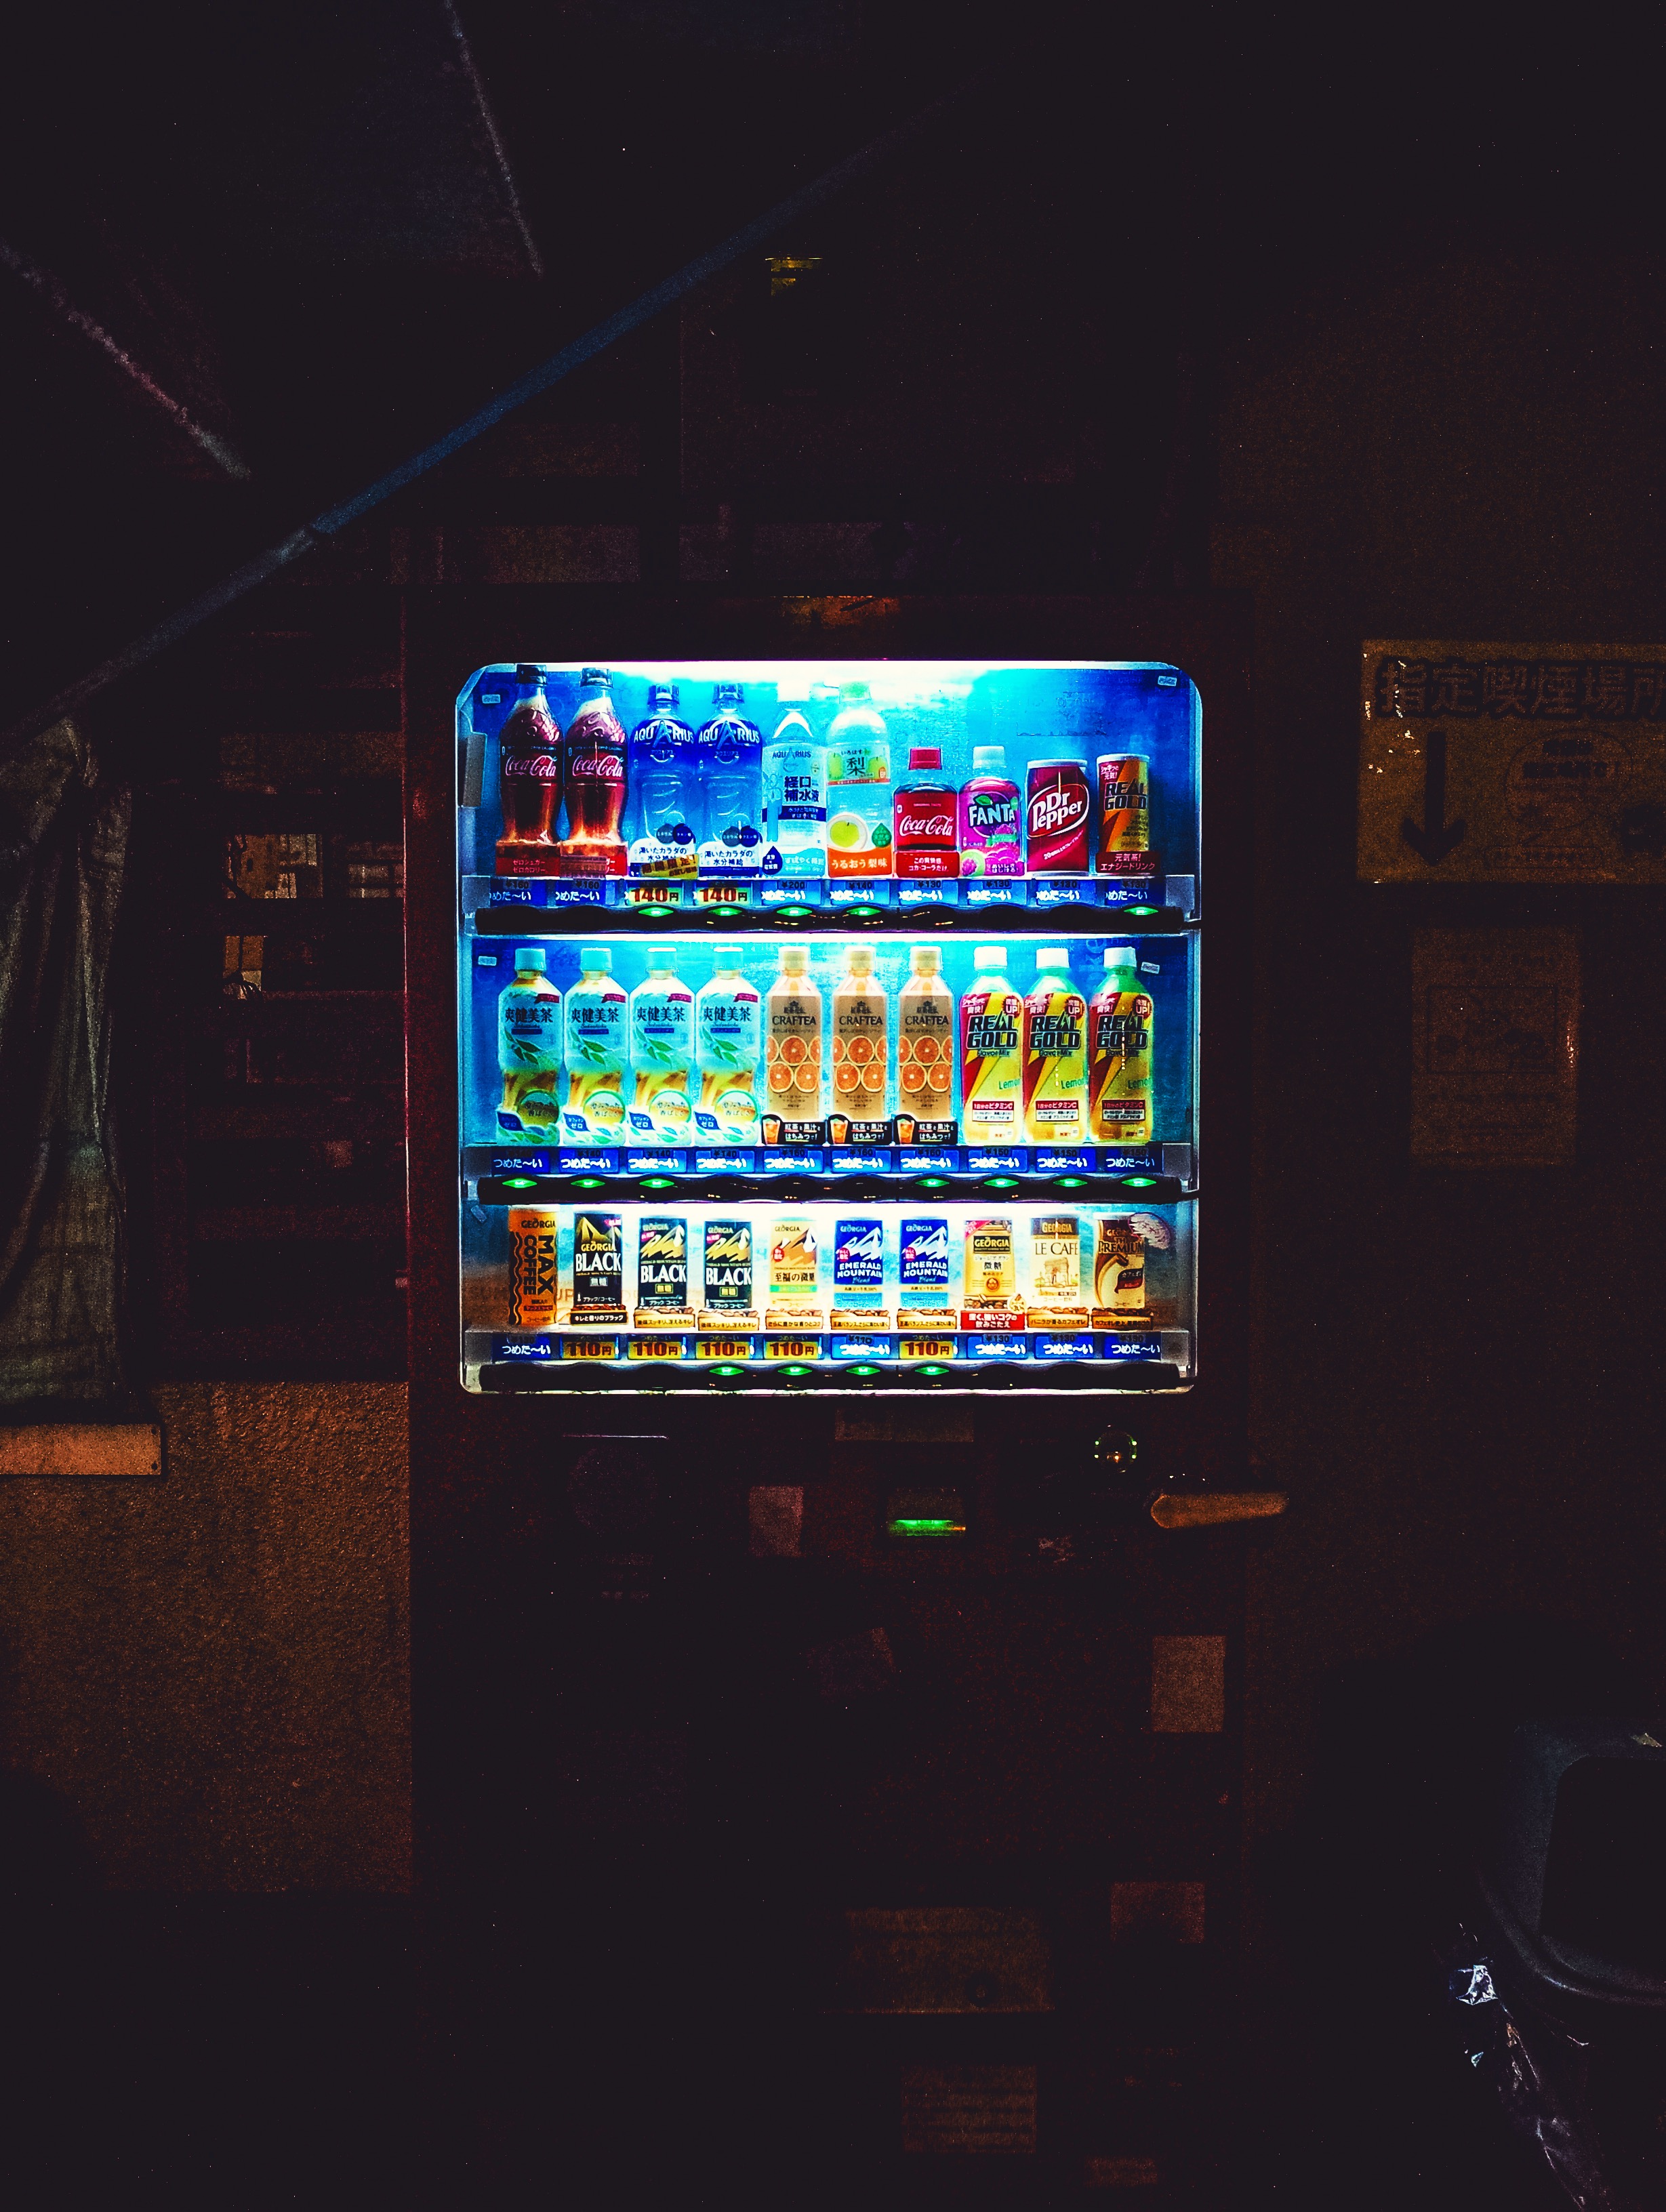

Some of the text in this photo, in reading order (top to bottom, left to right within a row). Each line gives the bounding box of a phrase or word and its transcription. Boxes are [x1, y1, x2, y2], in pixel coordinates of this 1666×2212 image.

[634, 720, 694, 747] AQUARIUS
[698, 720, 760, 748] AQUARIUS
[773, 747, 811, 762] AQUARIUS
[506, 755, 557, 777] Coca-Cola
[572, 755, 624, 777] Coca-Cola
[847, 756, 866, 776] 梨
[784, 776, 811, 788] 経口
[1105, 778, 1147, 796] REAL
[784, 789, 819, 802] 補水液
[1046, 792, 1071, 813] Dr
[1104, 796, 1147, 811] GOLD
[969, 804, 1015, 826] FANTA
[1032, 800, 1082, 832] Pepper
[899, 815, 954, 836] Coca-Cola
[1101, 863, 1155, 871] エナジードリンク
[781, 881, 805, 889] ¥200
[849, 881, 873, 889] ¥140
[631, 887, 679, 902] 140円
[700, 887, 748, 902] 140円
[505, 1007, 553, 1023] 爽健美茶
[572, 1007, 619, 1023] 爽健美茶
[637, 1006, 685, 1021] 爽健美茶
[704, 1006, 752, 1021] 爽健美茶
[772, 1016, 817, 1025] CRAFTEA
[839, 1016, 883, 1025] CRAFTEA
[905, 1015, 949, 1025] CRAFTEA
[969, 1011, 1018, 1032] REAL
[1032, 1011, 1081, 1032] REAL
[1098, 1011, 1149, 1032] REAL
[967, 1031, 1017, 1050] GOLD
[1029, 1031, 1080, 1050] GOLD
[1097, 1031, 1147, 1049] GOLD
[1042, 1222, 1072, 1233] GEORGIA
[581, 1241, 617, 1252] GEORGIA
[974, 1237, 1009, 1247] GEORGIA
[1035, 1243, 1047, 1254] LE
[523, 1235, 537, 1295] COFFEE
[538, 1235, 554, 1295] MAX
[575, 1252, 622, 1271] BLACK
[840, 1261, 881, 1270] EMERALD
[906, 1261, 947, 1270] EMERALD
[641, 1264, 686, 1283] BLACK
[706, 1267, 752, 1286] BLACK
[837, 1269, 882, 1278] MOUNTAIN
[903, 1269, 948, 1277] MOUNTAIN
[849, 1335, 872, 1344] ¥110
[633, 1342, 678, 1356] 110円
[701, 1342, 746, 1356] 110円
[769, 1342, 814, 1356] 110円
[905, 1342, 950, 1356] 110円
